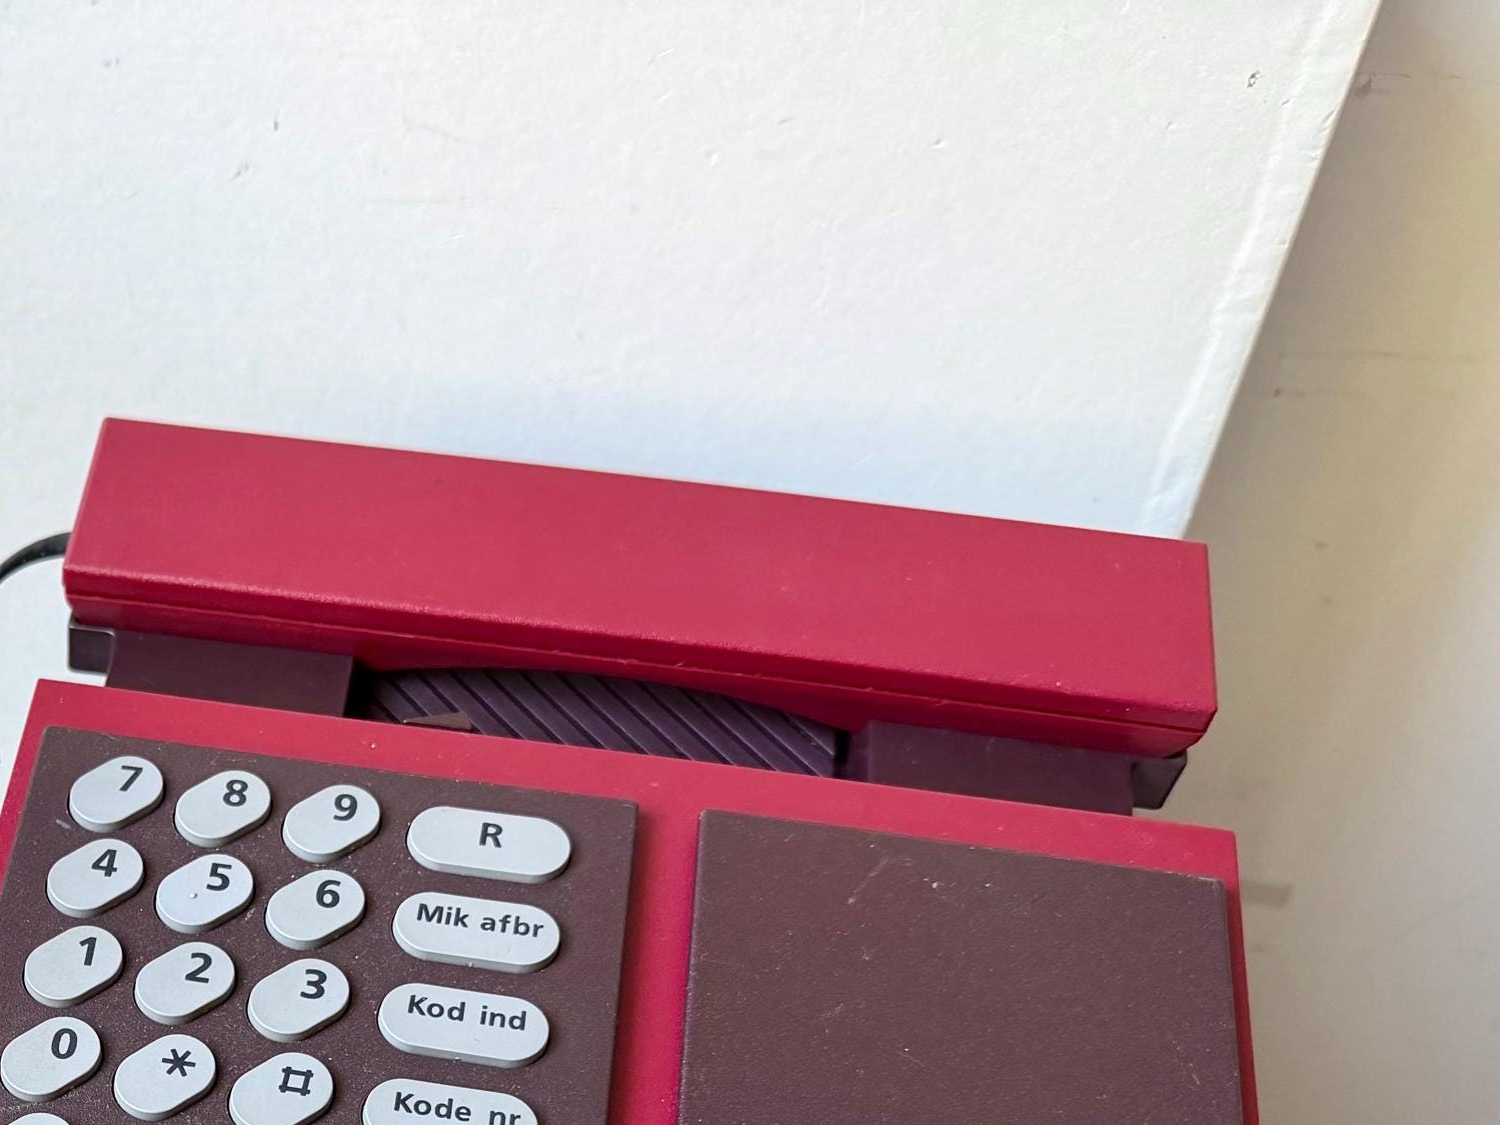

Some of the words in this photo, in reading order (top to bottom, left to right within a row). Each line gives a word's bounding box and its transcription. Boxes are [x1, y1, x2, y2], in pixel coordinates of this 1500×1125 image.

[120, 766, 143, 791] 7
[223, 780, 248, 806] 8
[334, 794, 357, 821] 9
[480, 823, 502, 848] R
[92, 849, 117, 877] 4
[206, 862, 232, 892] 5
[316, 880, 340, 908] 6
[417, 904, 468, 928] Mik
[481, 915, 544, 937] afbr
[80, 937, 96, 966] 1
[185, 953, 212, 983] 2
[300, 969, 327, 999] 3
[408, 995, 465, 1021] Kod
[480, 1006, 526, 1030] ind
[51, 1028, 77, 1059] 0
[394, 1092, 471, 1121] Kode
